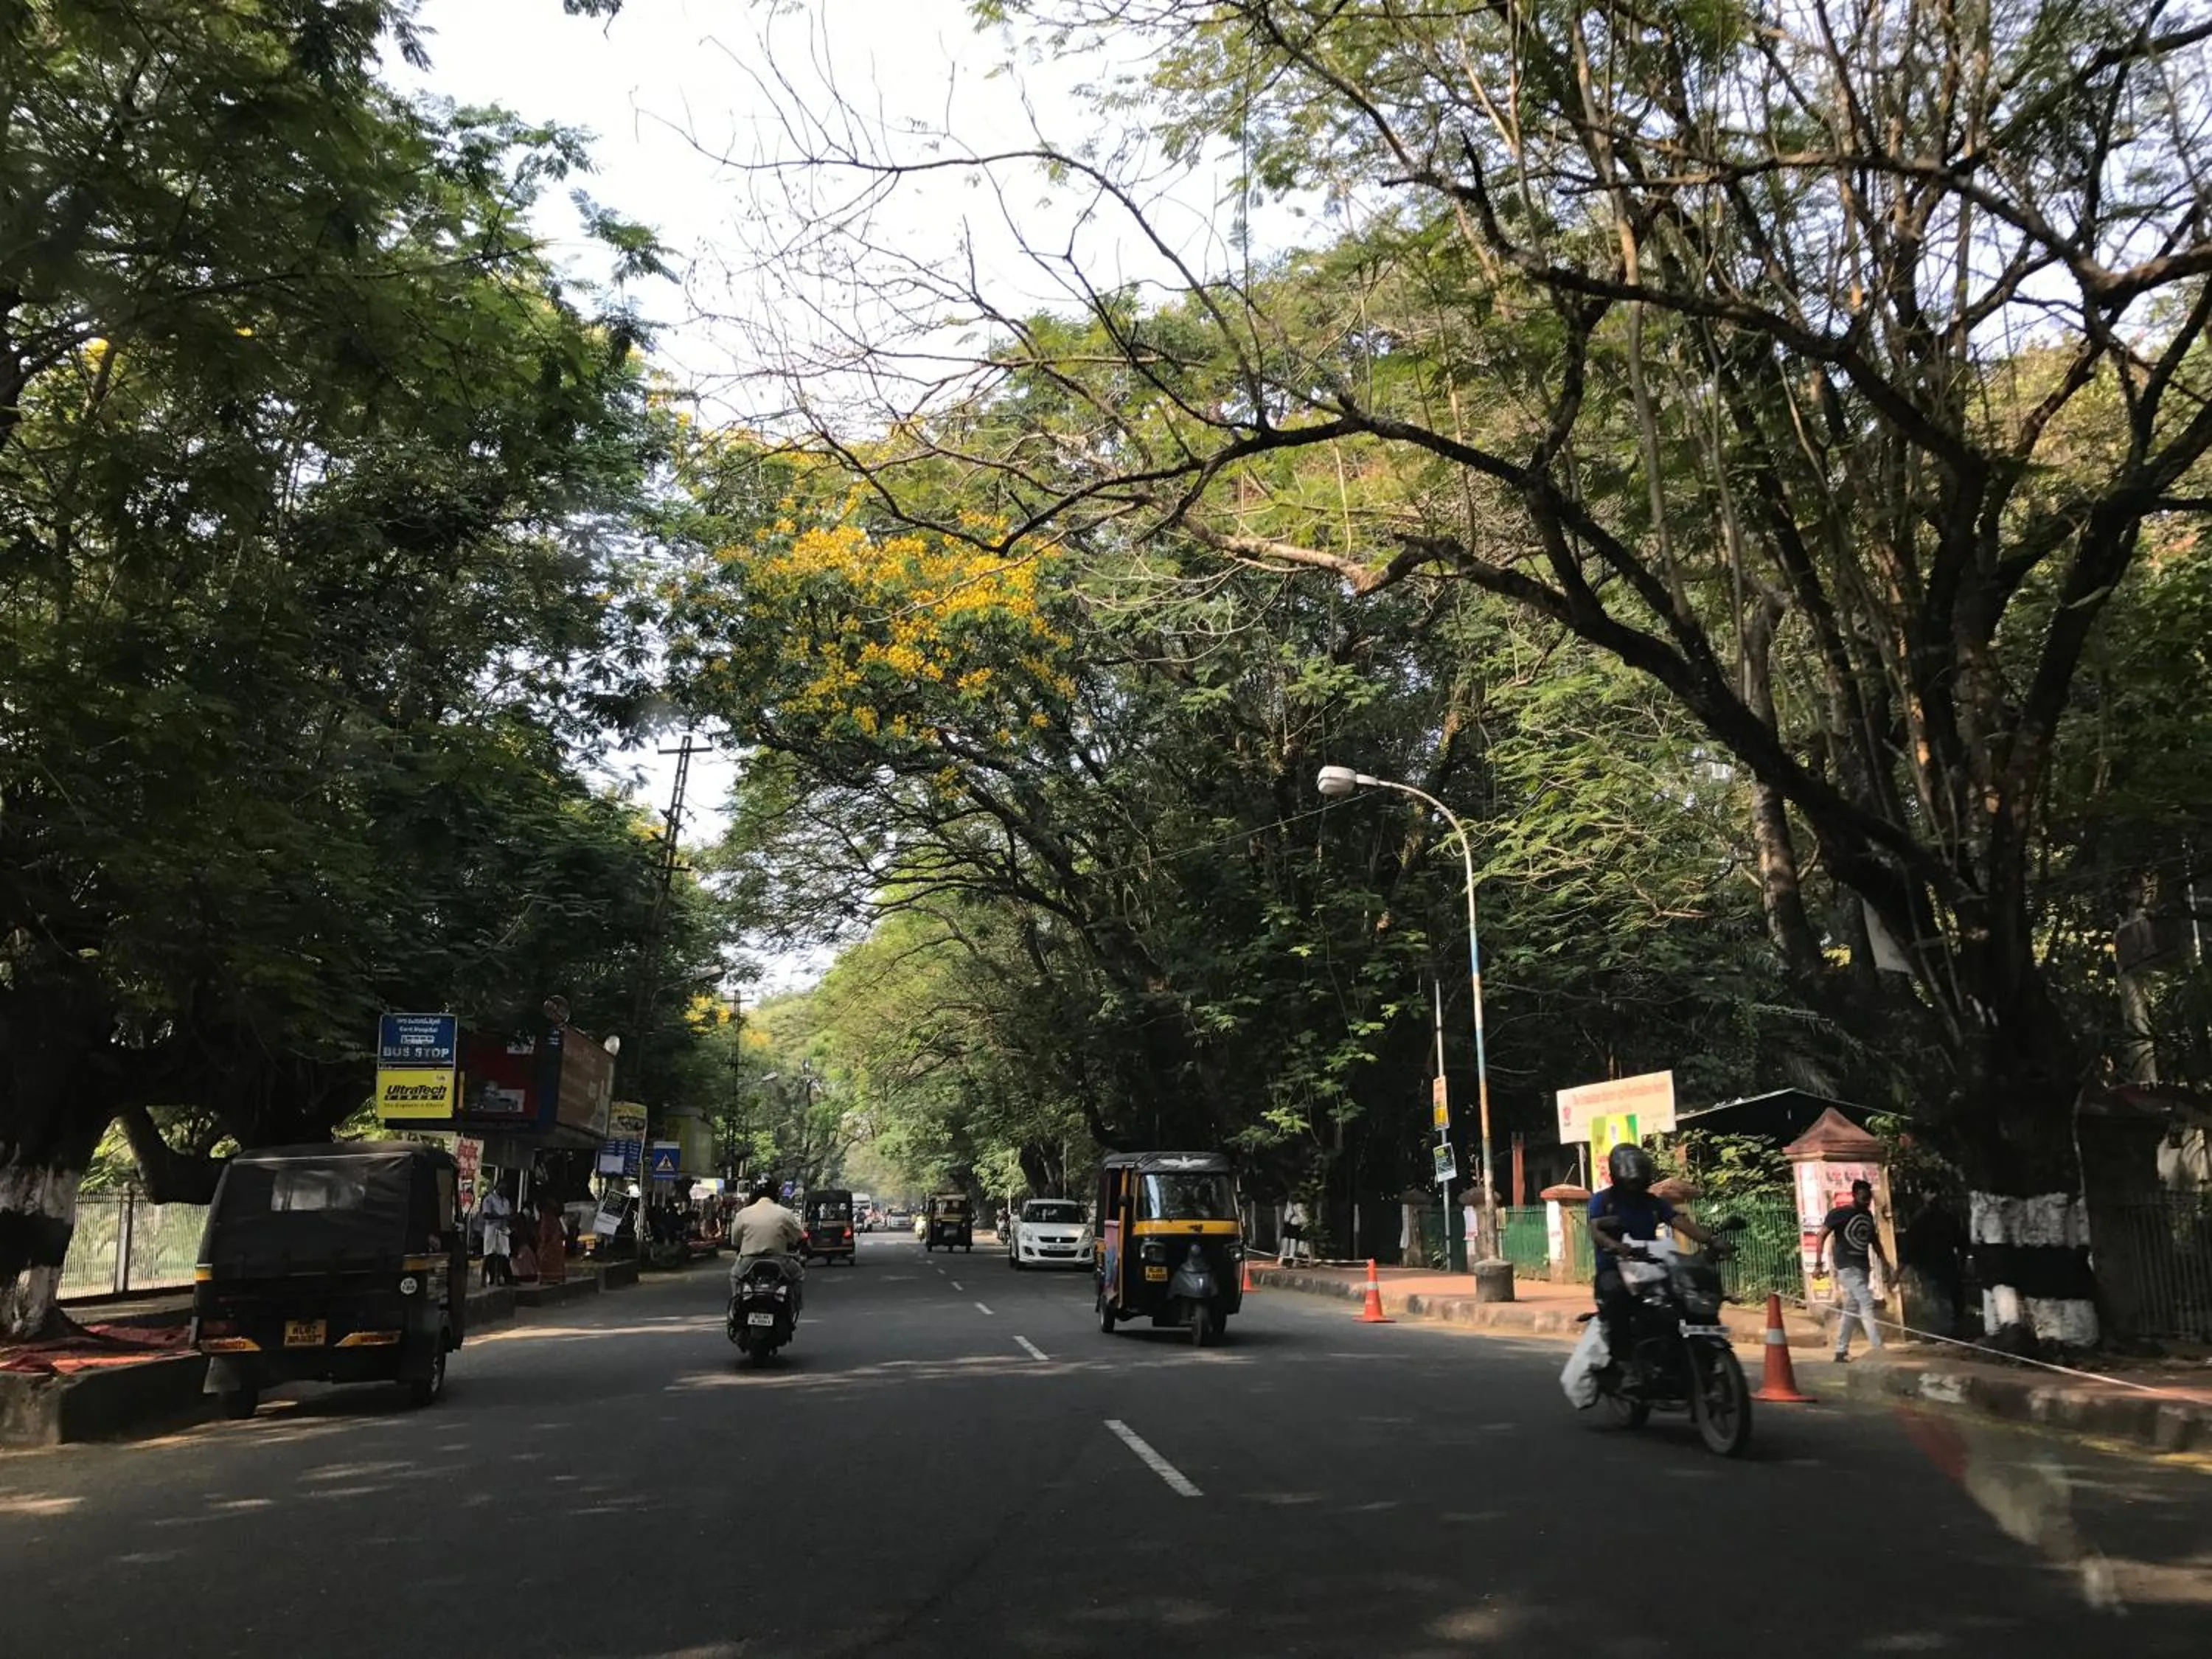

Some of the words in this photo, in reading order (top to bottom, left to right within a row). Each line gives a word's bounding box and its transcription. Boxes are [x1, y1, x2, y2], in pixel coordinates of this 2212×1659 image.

[383, 1046, 410, 1057] BUS
[415, 1047, 450, 1058] STOP
[386, 1085, 448, 1095] UltraTech
